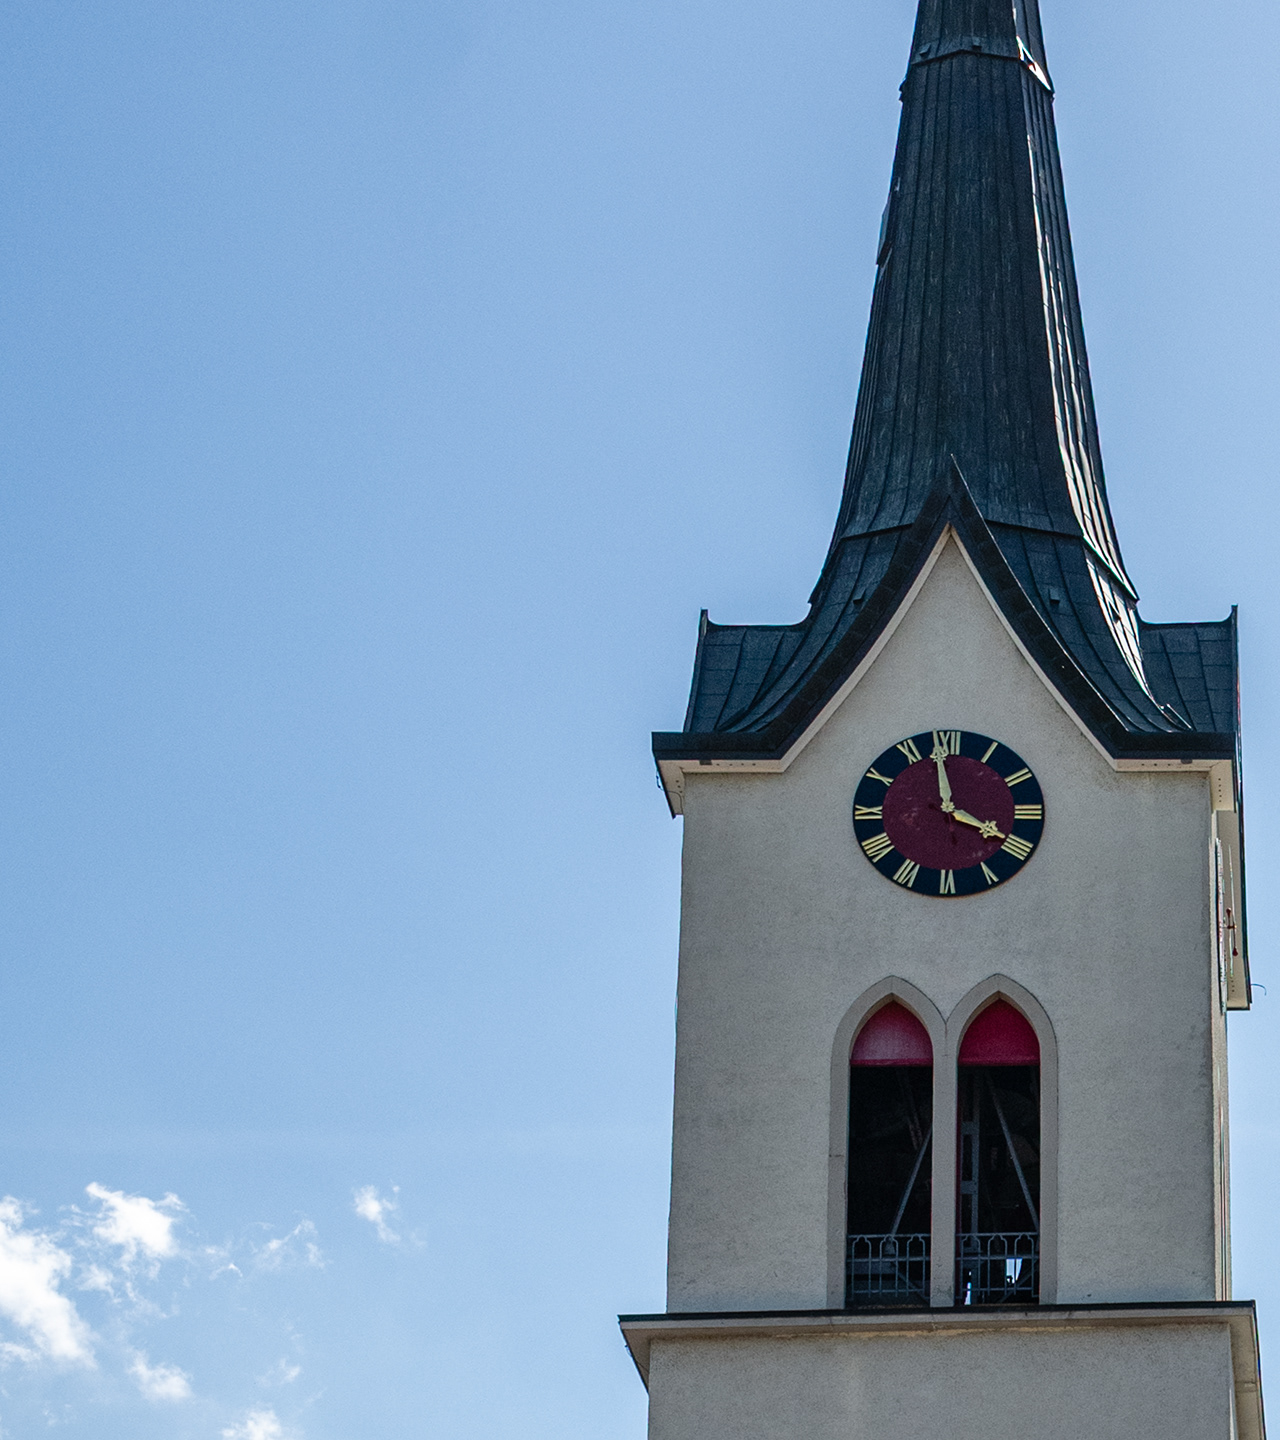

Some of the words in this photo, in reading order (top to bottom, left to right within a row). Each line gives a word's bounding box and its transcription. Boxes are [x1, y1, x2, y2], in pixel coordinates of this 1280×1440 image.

[896, 739, 922, 765] XI
[980, 741, 998, 764] I
[865, 767, 894, 787] X
[1004, 767, 1032, 787] II
[854, 804, 883, 820] IX
[1014, 804, 1042, 820] III
[861, 831, 895, 863] VIII
[1000, 833, 1034, 861] IIII
[893, 858, 920, 888] VII
[939, 869, 956, 894] VI
[980, 861, 999, 885] V
